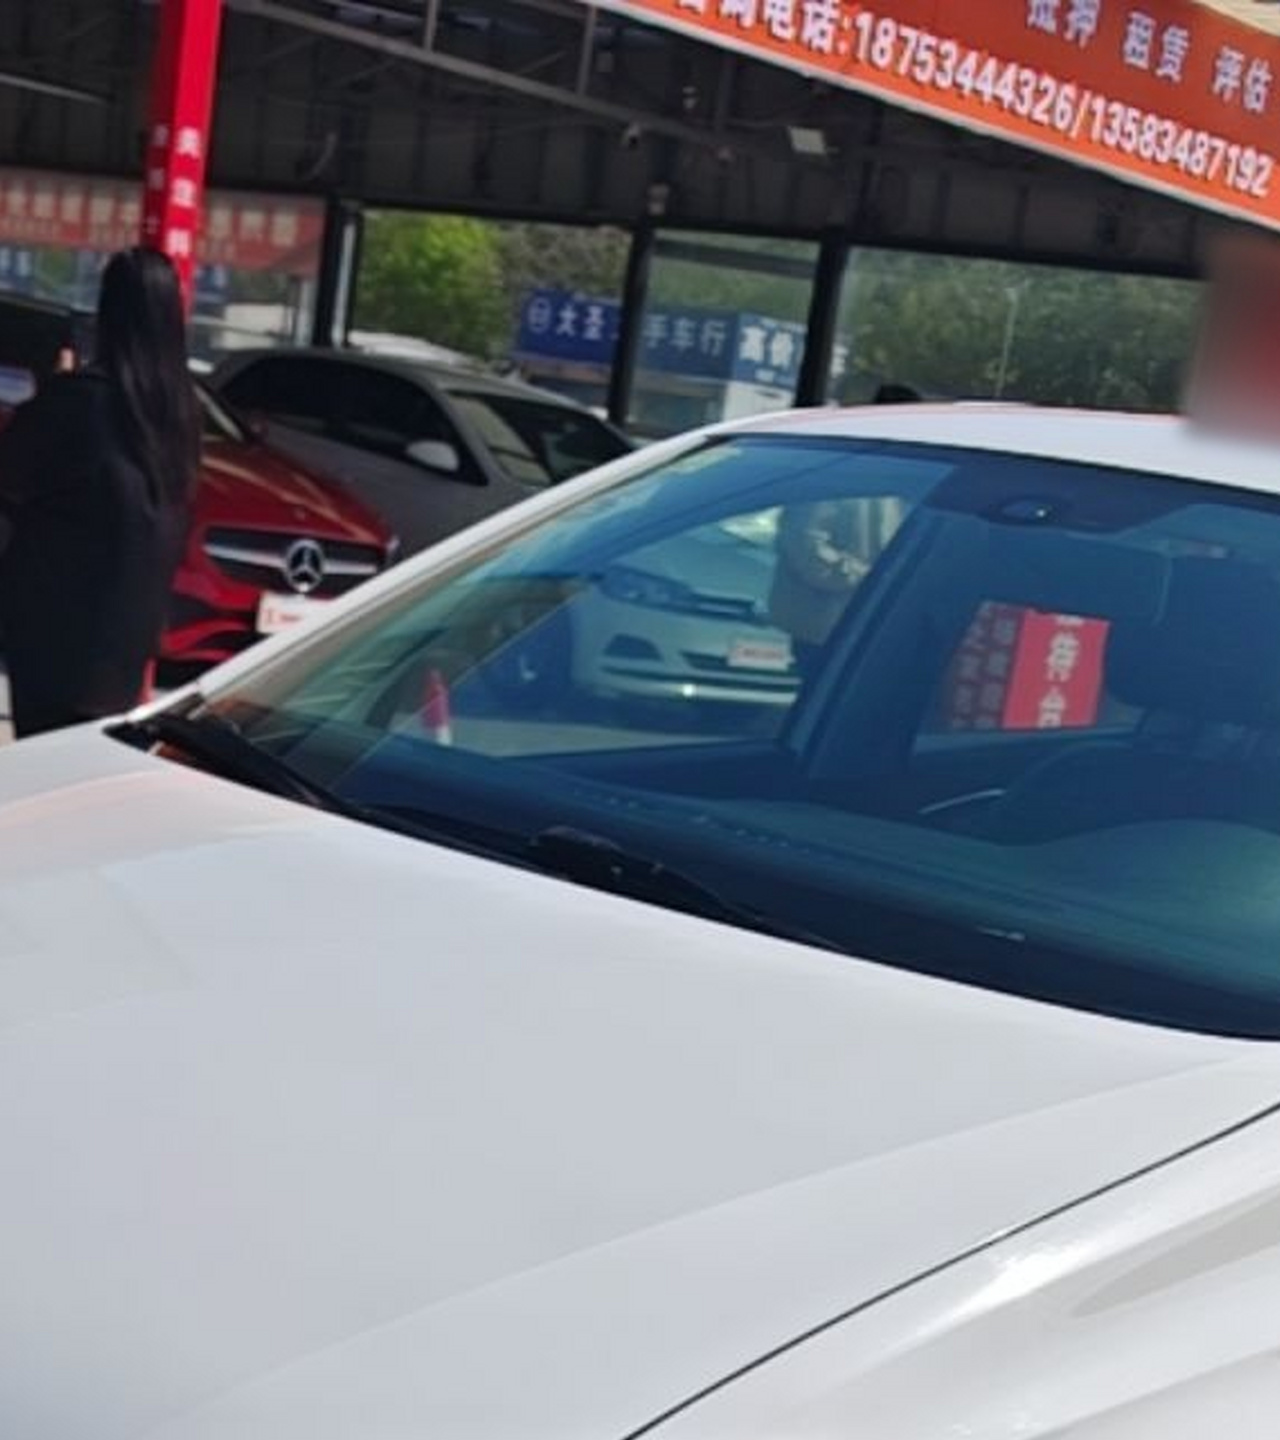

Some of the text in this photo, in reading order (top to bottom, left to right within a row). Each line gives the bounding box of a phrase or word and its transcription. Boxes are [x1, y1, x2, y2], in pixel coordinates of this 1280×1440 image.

[678, 0, 1274, 198] 电话:18753444326/13583487192
[1122, 10, 1191, 83] 租赁
[1213, 45, 1272, 113] 评估
